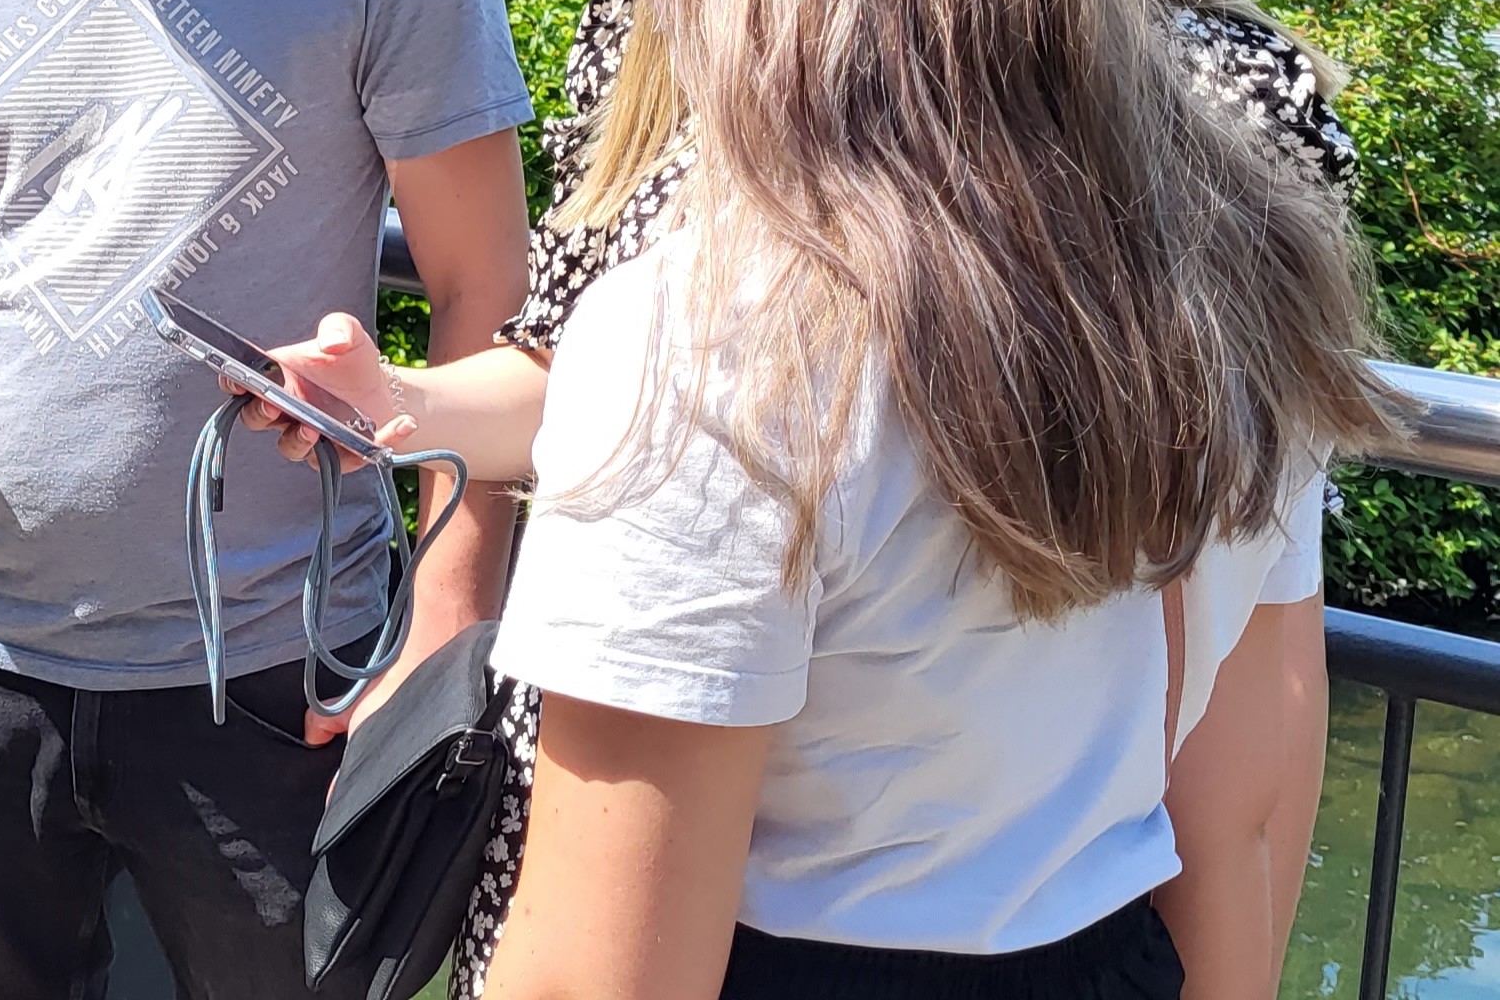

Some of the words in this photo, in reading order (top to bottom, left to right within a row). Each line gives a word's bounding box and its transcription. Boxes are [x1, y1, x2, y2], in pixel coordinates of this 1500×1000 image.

[213, 48, 299, 128] NINETY
[240, 155, 299, 216] JACK
[217, 212, 241, 235] &
[160, 231, 219, 291] JONE
